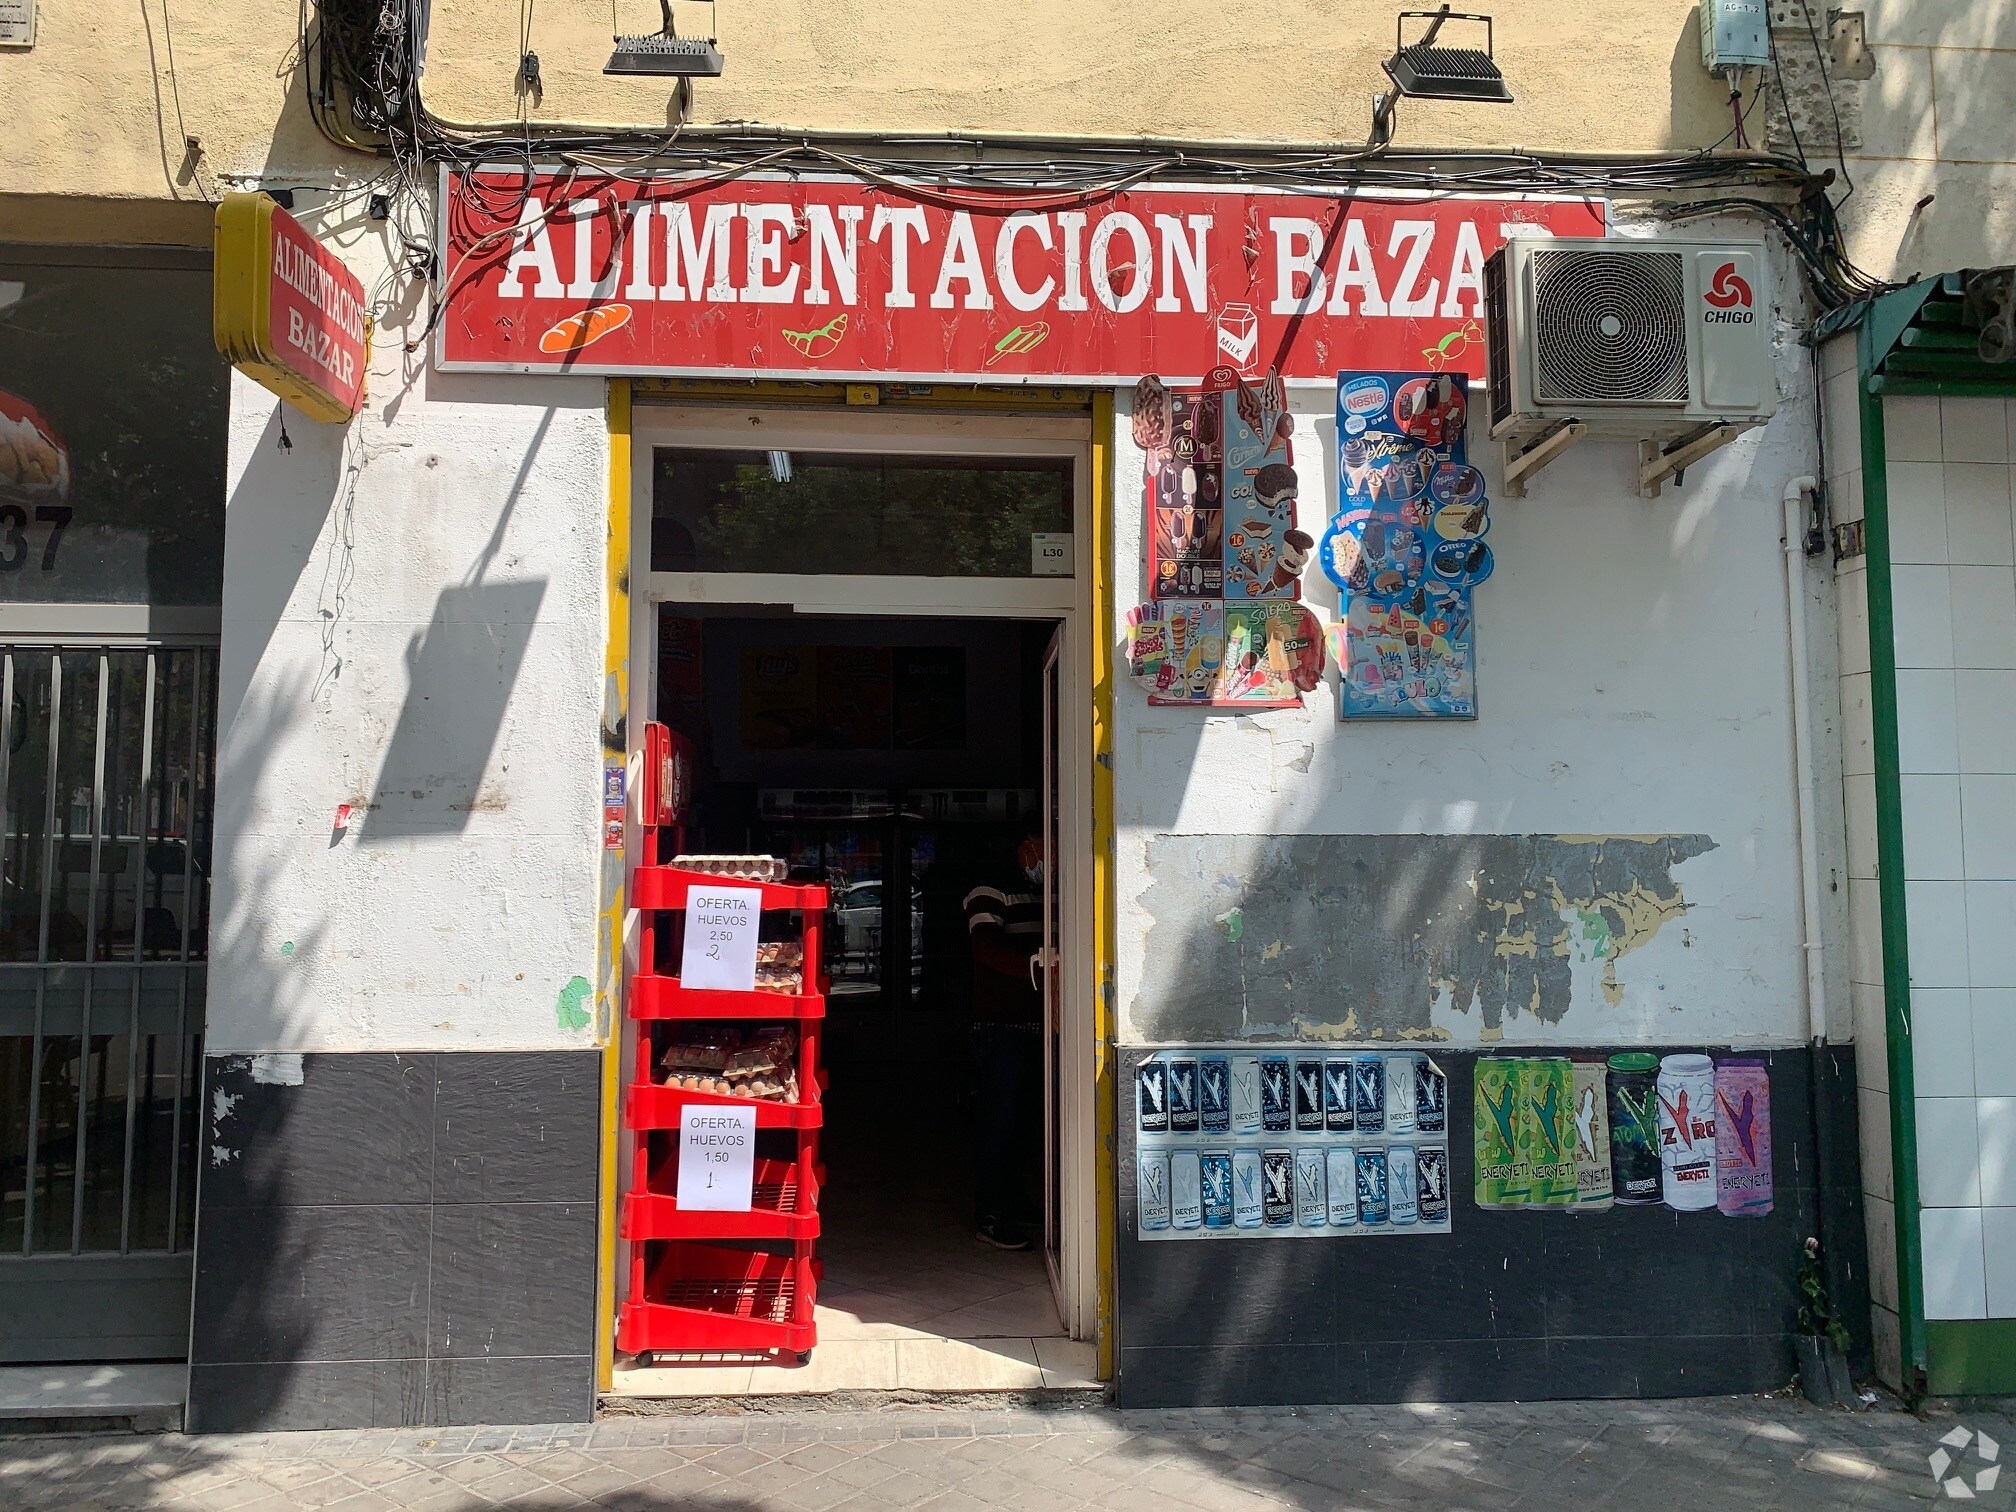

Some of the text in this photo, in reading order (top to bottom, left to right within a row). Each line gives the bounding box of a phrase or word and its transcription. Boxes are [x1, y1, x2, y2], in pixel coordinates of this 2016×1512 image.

[497, 197, 1213, 314] ALIMENTACION
[273, 231, 365, 347] ALIMENTACION
[1704, 311, 1754, 324] CHIGO
[288, 306, 355, 390] BAZAR
[1218, 335, 1243, 357] MILK
[1348, 379, 1378, 390] HELADOS
[1231, 485, 1253, 499] GO!
[0, 504, 73, 572] 37
[1232, 536, 1242, 545] 1€
[1043, 548, 1063, 557] L30
[1439, 543, 1466, 553] OREO
[1165, 564, 1175, 574] 1€
[1250, 602, 1290, 624] SOLERO
[1434, 623, 1445, 633] 1€
[1285, 642, 1298, 651] 50
[698, 915, 747, 926] HUEVOS
[706, 944, 720, 961] 2
[690, 1135, 744, 1146] HUEVOS
[1482, 1163, 1529, 1181] ENERYETI
[1676, 1169, 1710, 1182] ENERYETI
[1722, 1172, 1770, 1191] ENERYETI
